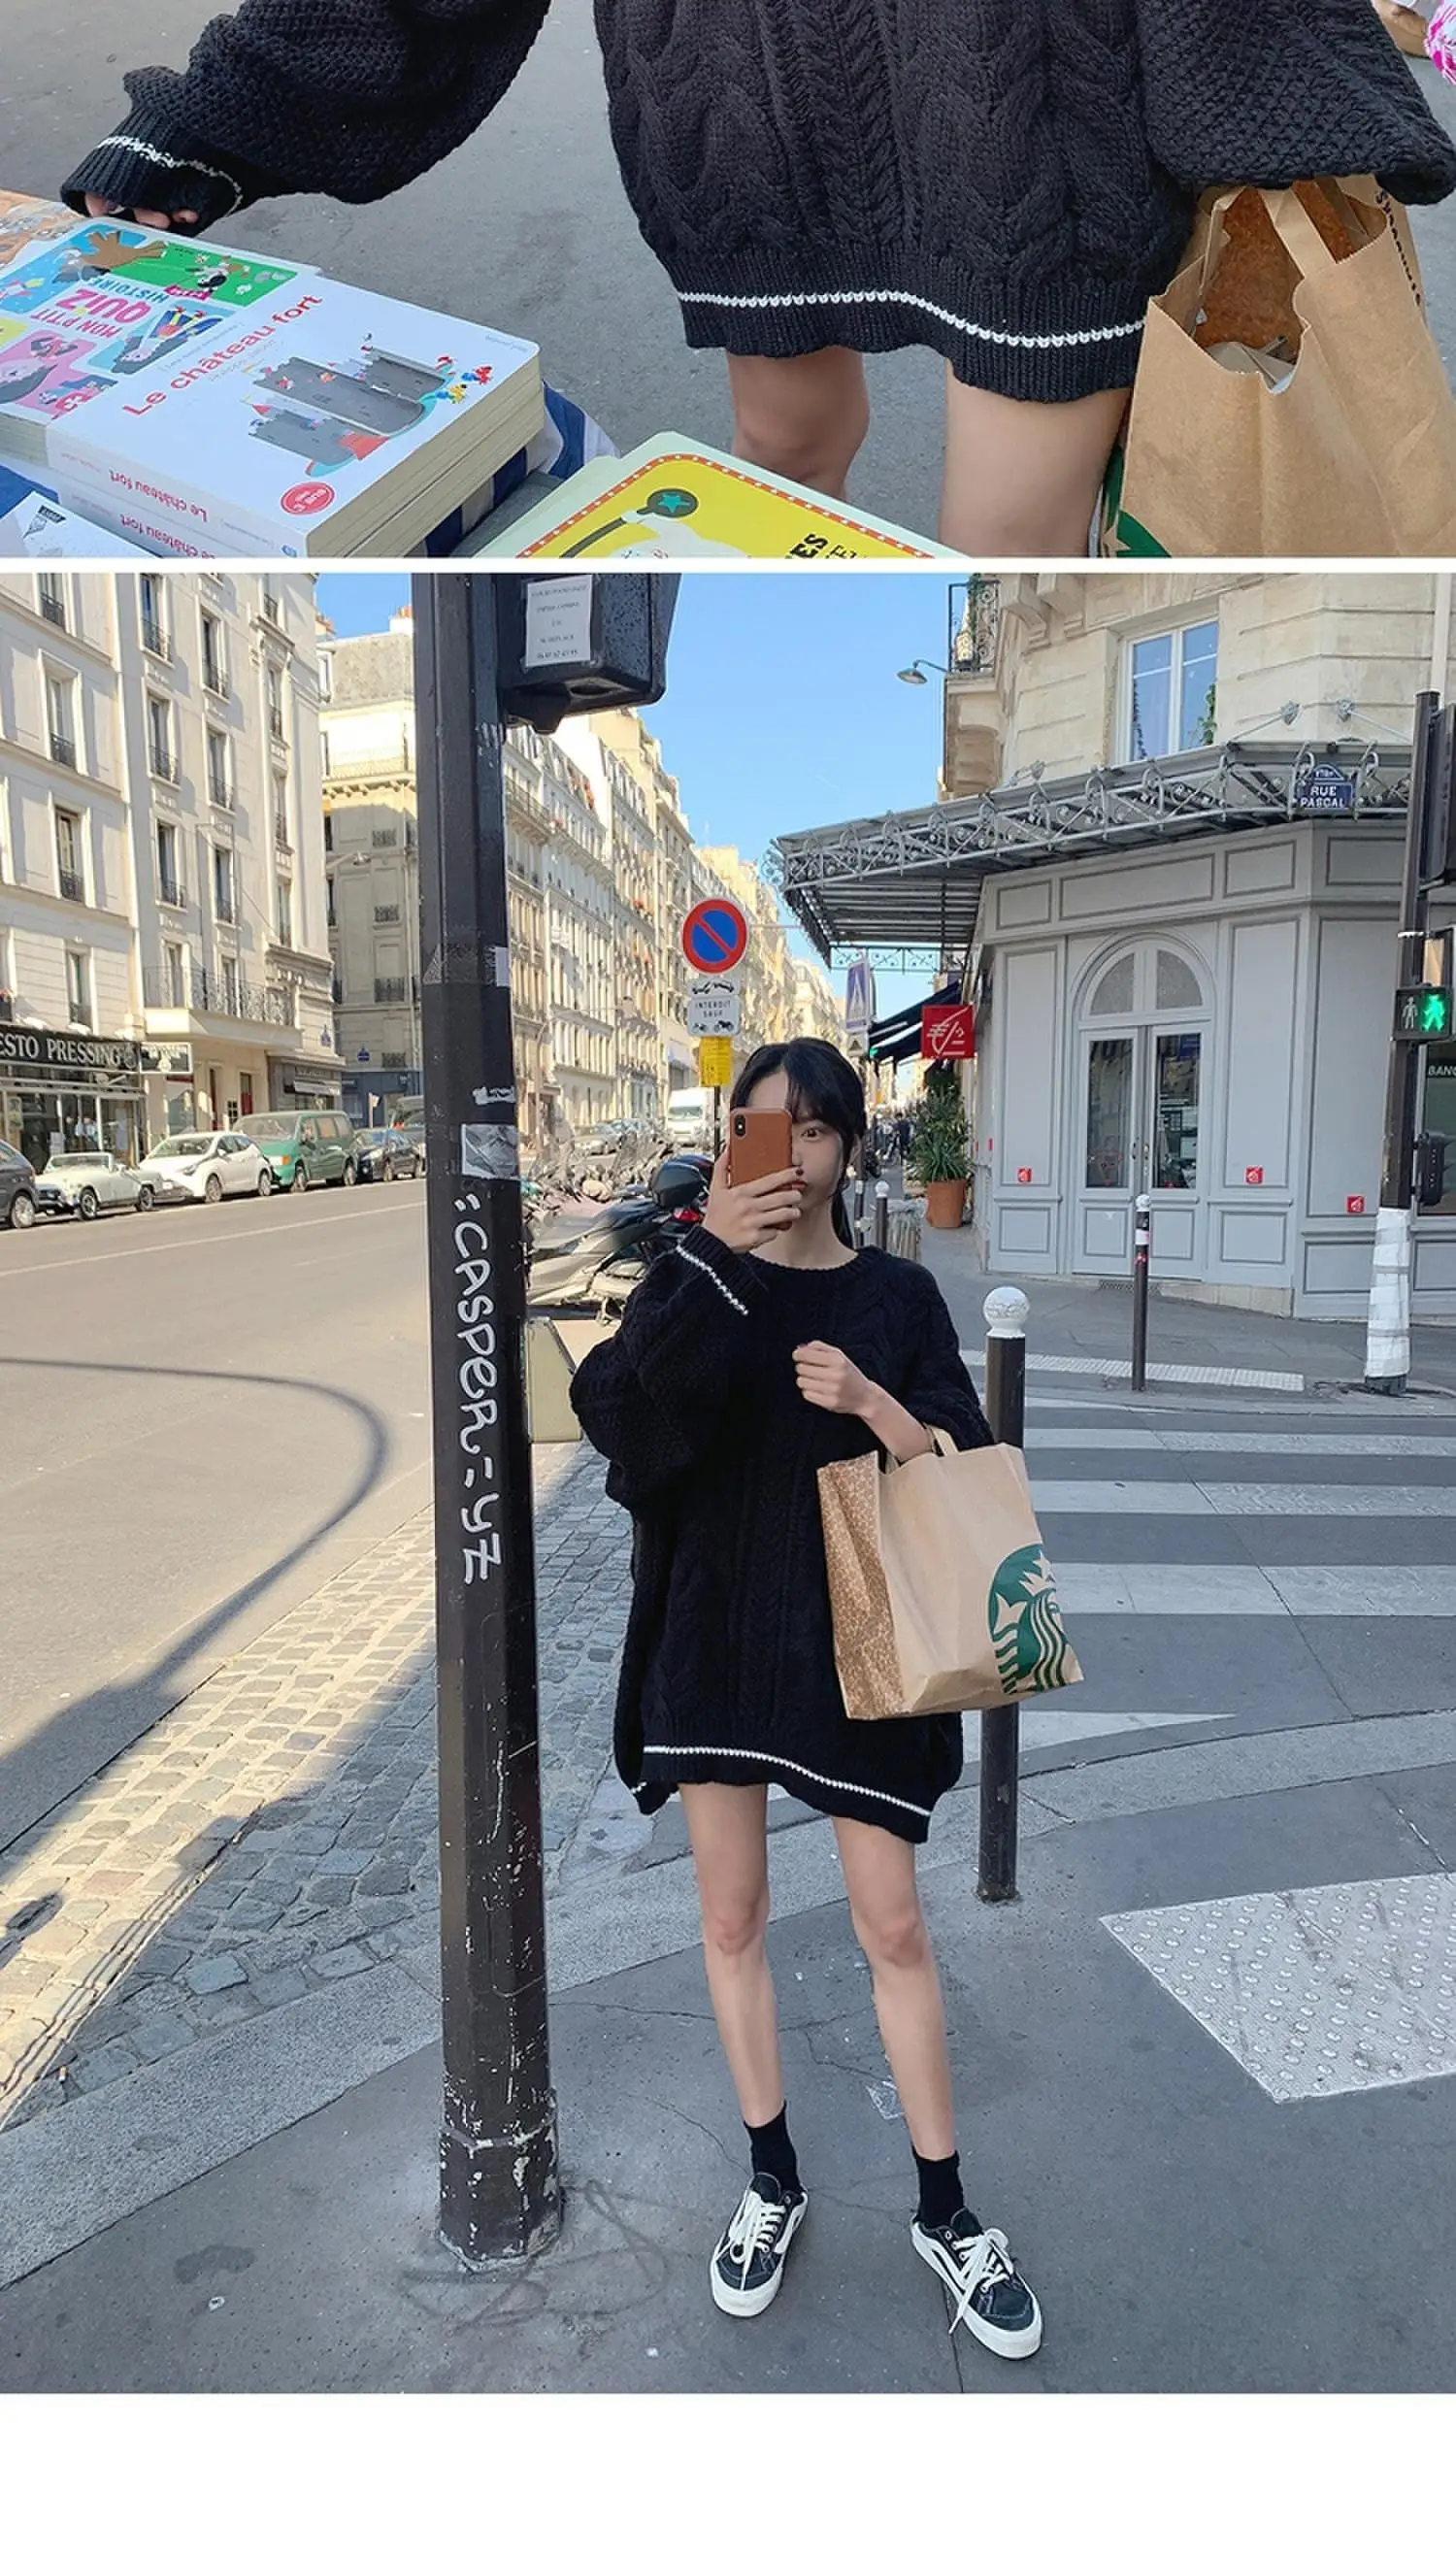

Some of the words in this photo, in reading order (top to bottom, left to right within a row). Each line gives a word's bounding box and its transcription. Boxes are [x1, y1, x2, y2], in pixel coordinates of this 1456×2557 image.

[55, 288, 151, 323] QUIZ
[76, 319, 122, 338] MON
[122, 391, 167, 415] Le
[170, 324, 276, 389] château
[272, 294, 323, 324] fort
[190, 501, 208, 522] Le
[1310, 785, 1337, 796] RUE
[1301, 797, 1346, 808] PASCAL
[46, 1038, 122, 1067] PRESSING
